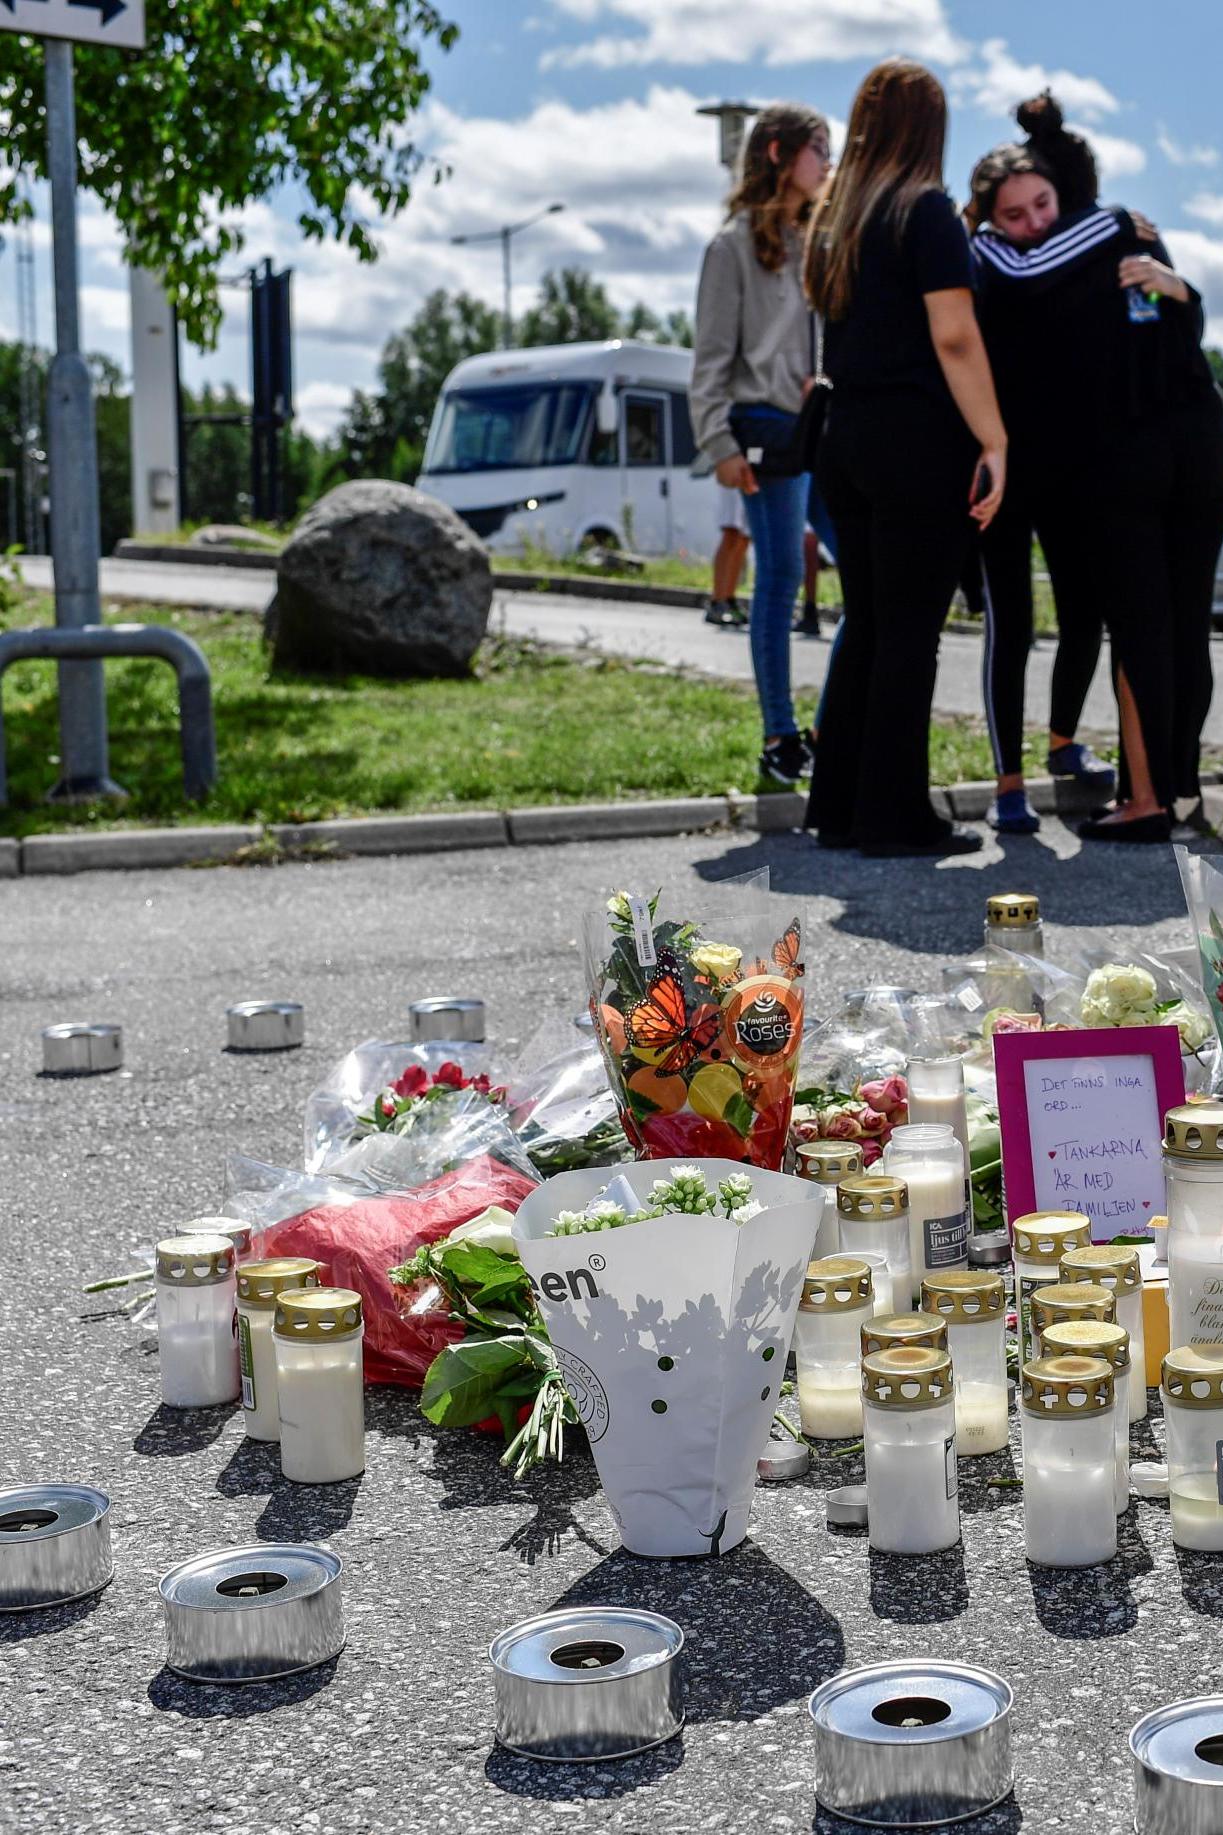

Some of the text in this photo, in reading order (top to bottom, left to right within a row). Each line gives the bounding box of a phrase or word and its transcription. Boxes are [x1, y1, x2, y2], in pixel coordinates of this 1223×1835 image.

[732, 1022, 796, 1044] Roses
[1041, 1078, 1067, 1092] DET
[1114, 1076, 1143, 1089] INGA
[1054, 1139, 1148, 1160] TANKARNA
[1053, 1168, 1113, 1191] ÄR MED
[1061, 1199, 1136, 1217] FAMILJEN
[929, 1222, 942, 1231] ICA
[930, 1233, 950, 1248] ljus
[570, 1360, 606, 1419] CRAFTED
